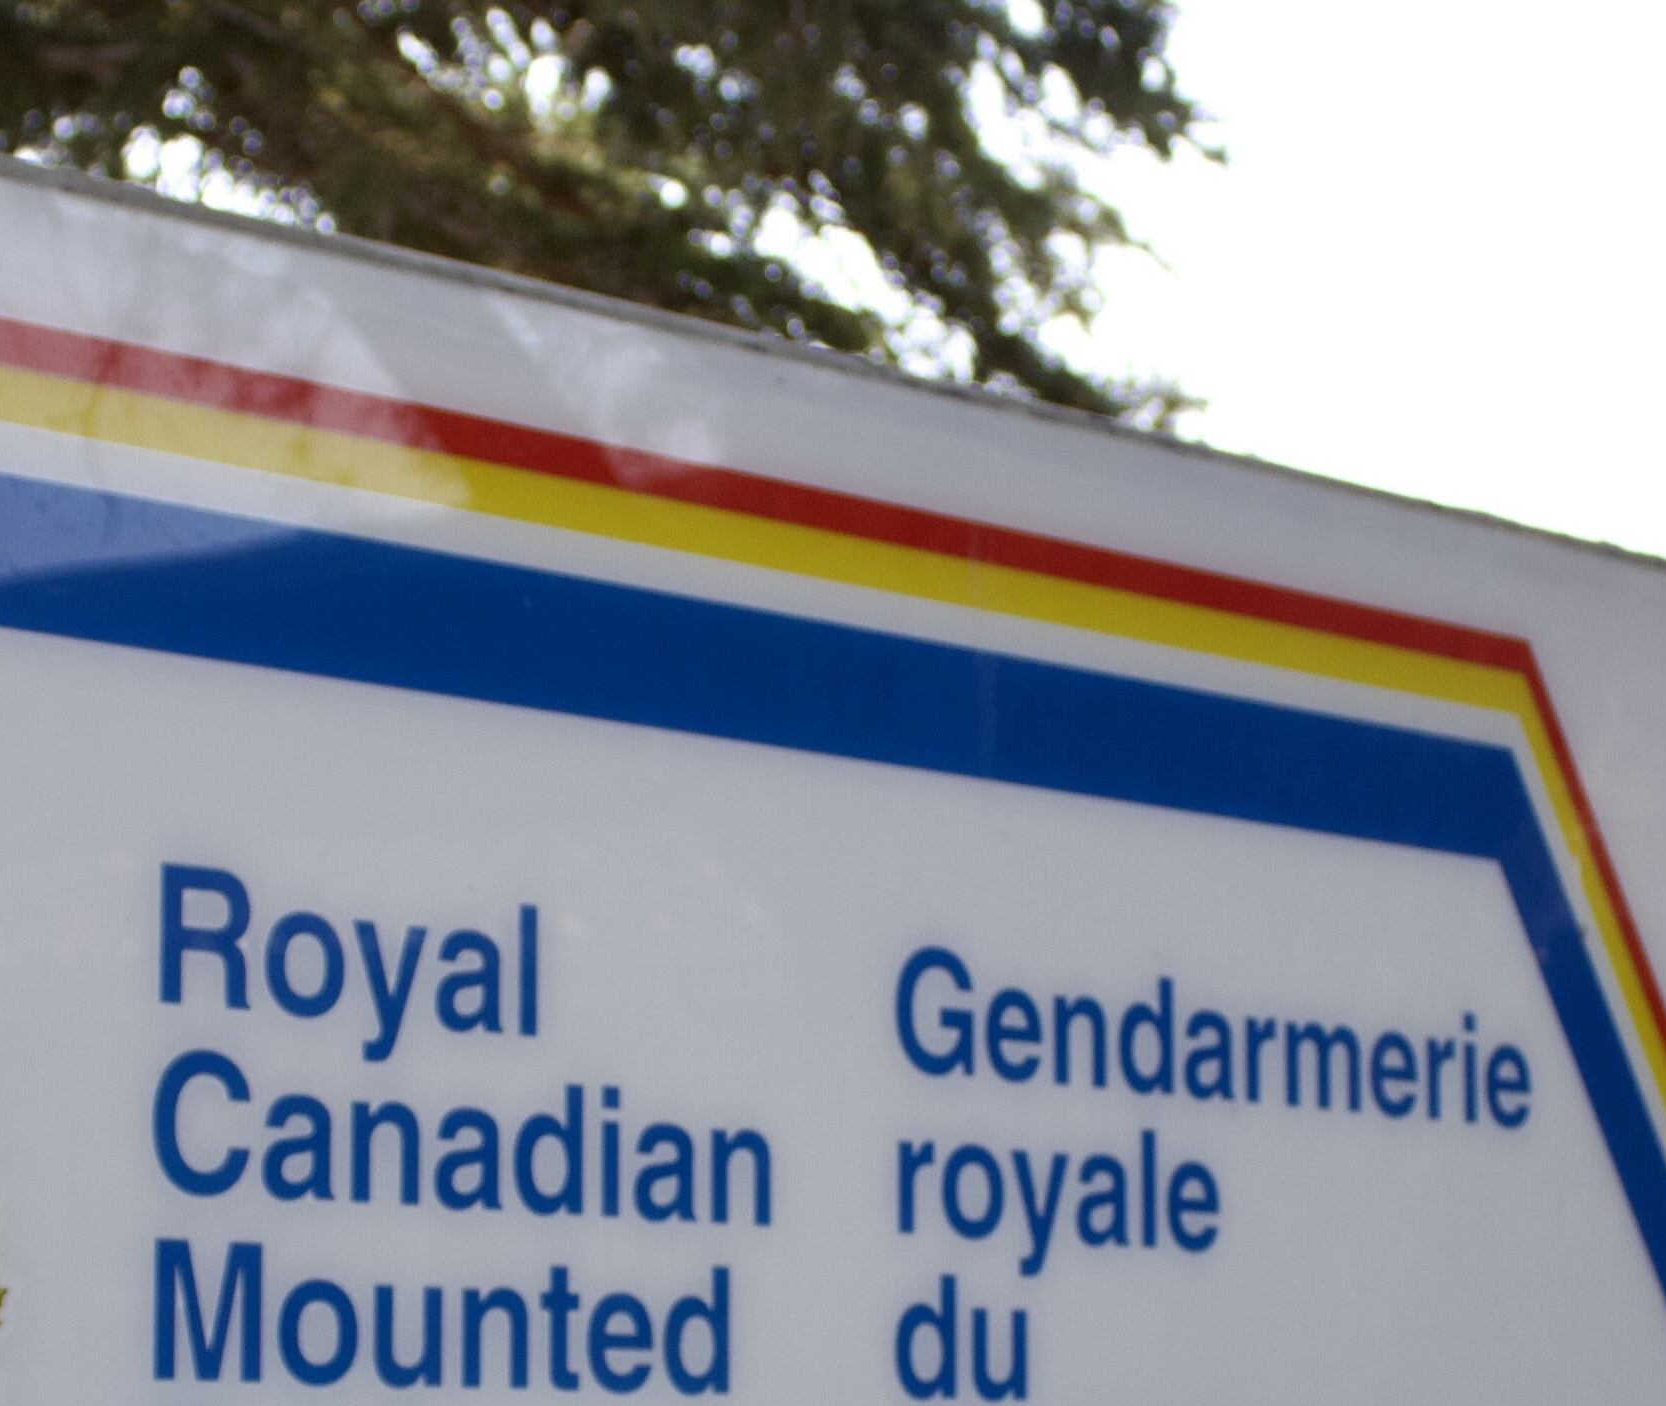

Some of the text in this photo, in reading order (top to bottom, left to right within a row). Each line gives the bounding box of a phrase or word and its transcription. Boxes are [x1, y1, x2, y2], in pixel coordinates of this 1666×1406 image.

[159, 863, 539, 1063] Royal
[895, 946, 1533, 1129] Gendarmerie
[152, 1049, 772, 1228] Canadian
[897, 1129, 1221, 1278] royale
[153, 1238, 730, 1397] Mounted
[894, 1274, 1030, 1404] du
